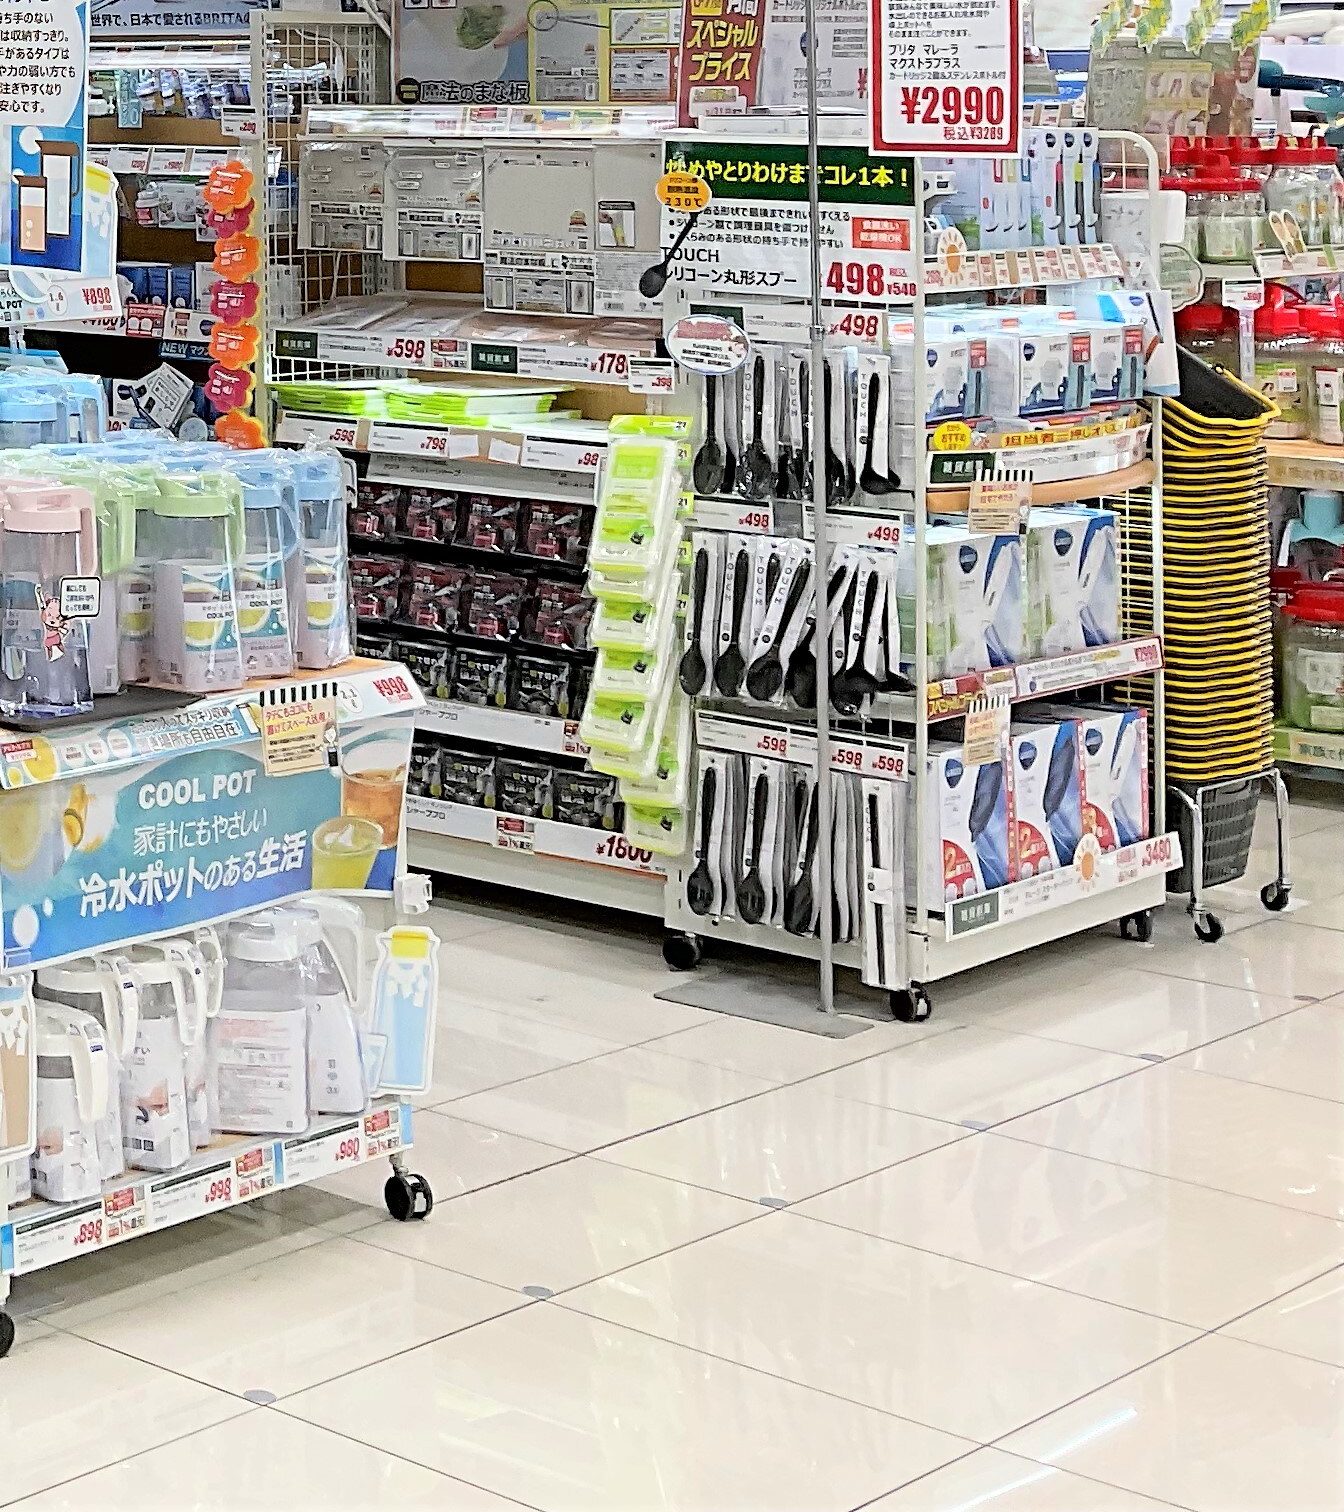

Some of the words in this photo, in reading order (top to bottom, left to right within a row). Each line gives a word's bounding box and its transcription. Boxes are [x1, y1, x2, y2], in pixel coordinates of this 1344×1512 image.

[686, 20, 759, 49] スペシャル
[923, 44, 959, 56] マレーラ
[688, 52, 752, 82] プライス
[901, 86, 1004, 126] ¥2990
[138, 779, 208, 811] COOL
[212, 769, 257, 801] POT
[132, 809, 268, 858] 家計にもやさしい
[79, 830, 308, 919] 冷水ポットのある生活
